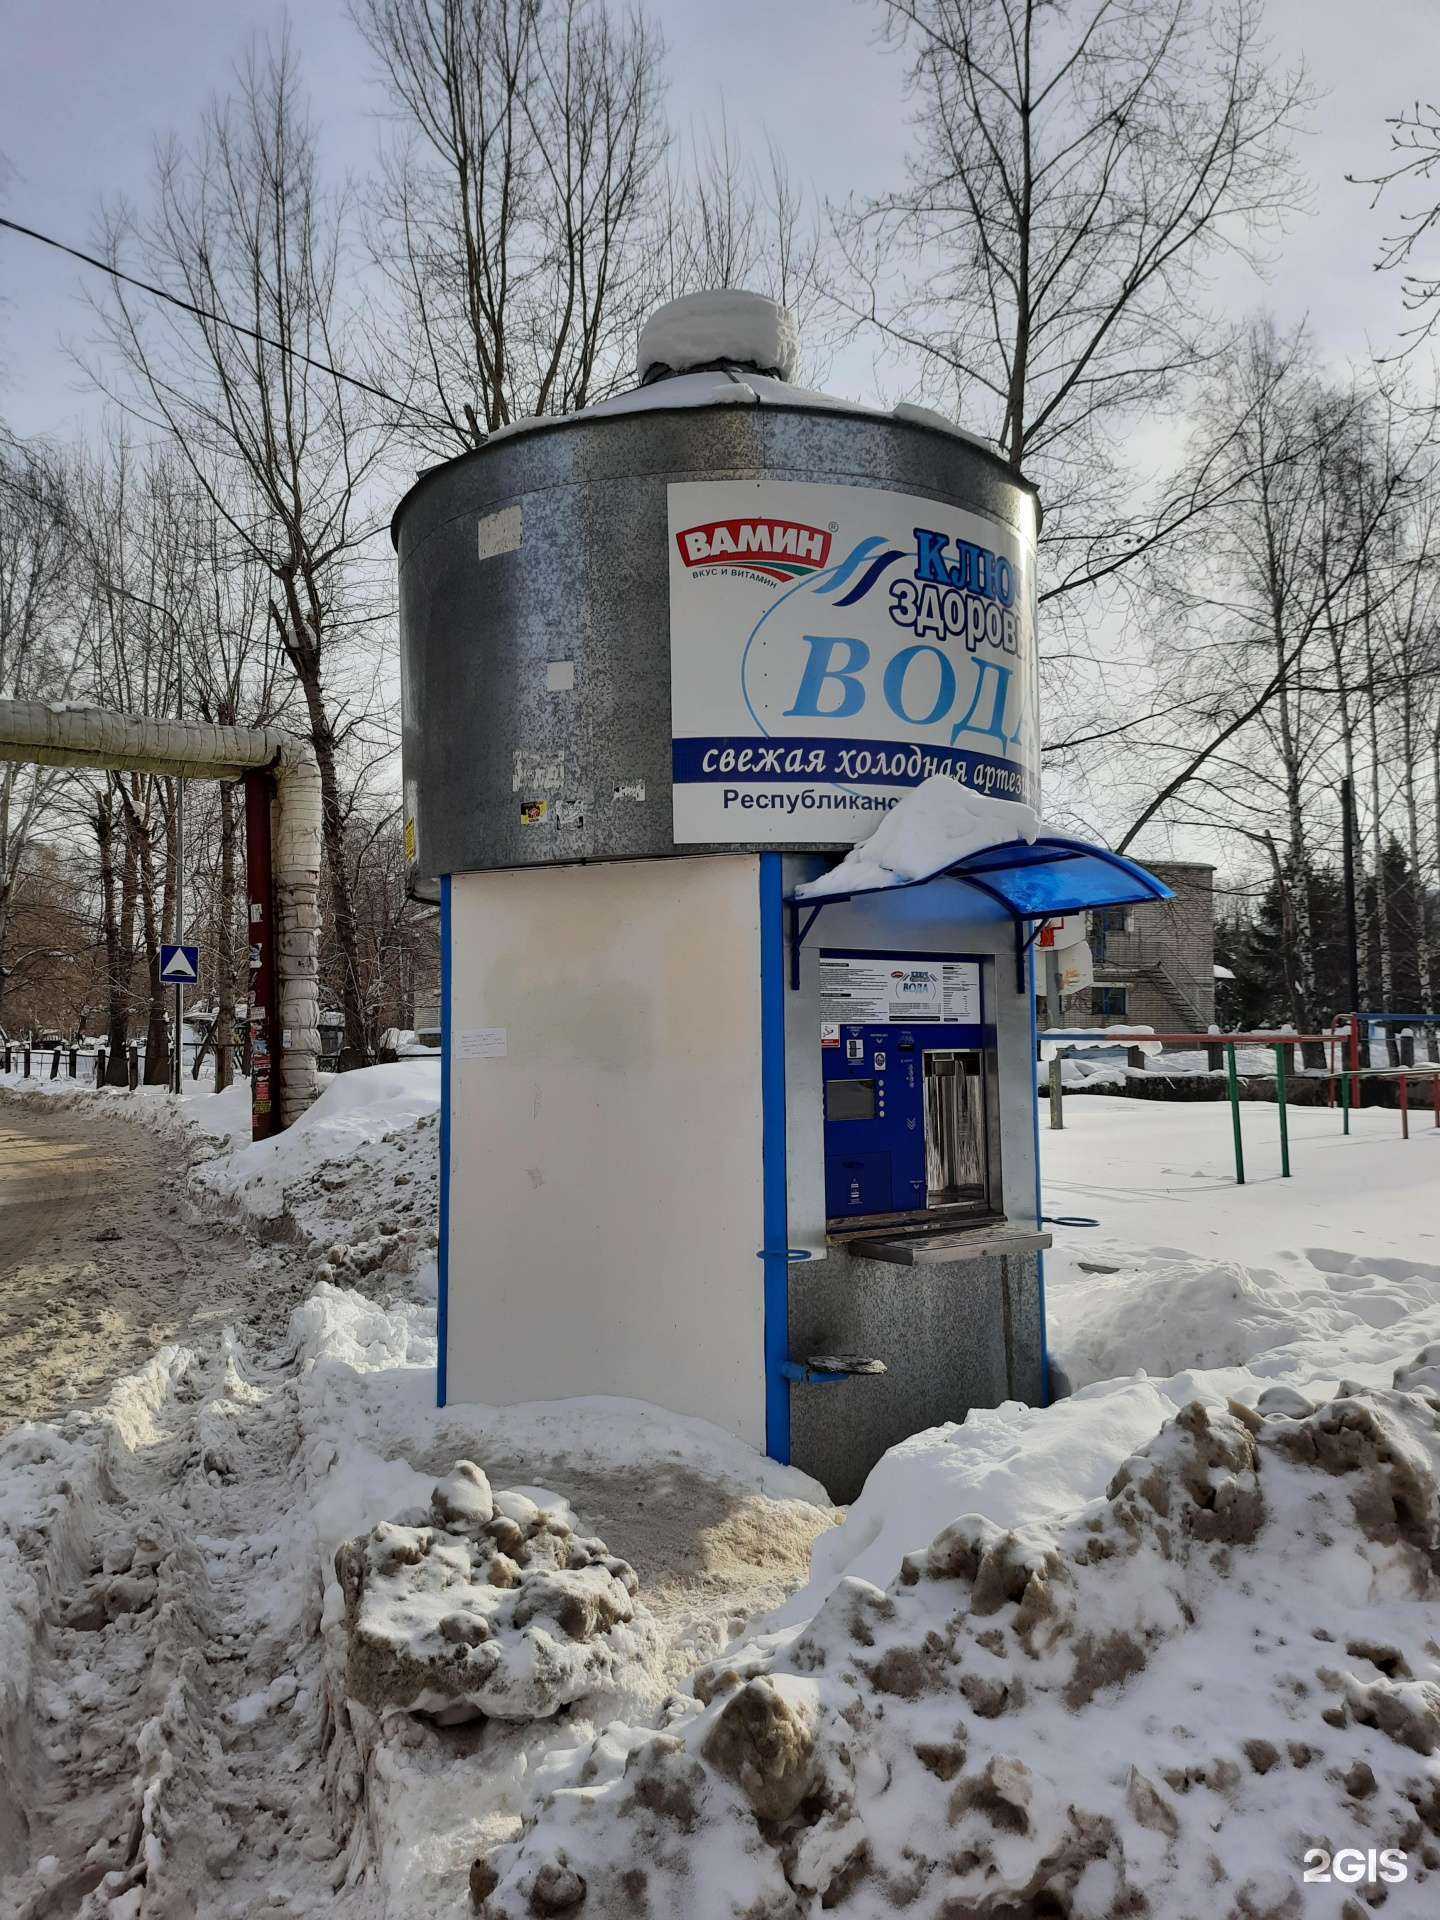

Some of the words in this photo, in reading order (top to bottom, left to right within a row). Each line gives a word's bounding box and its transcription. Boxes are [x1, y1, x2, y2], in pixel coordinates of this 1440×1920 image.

[683, 524, 824, 561] ВАМИН
[692, 568, 718, 579] ВКУС
[721, 568, 729, 576] И
[731, 569, 778, 589] ВИТАМИН
[913, 527, 1019, 609] КЛЮ
[702, 748, 826, 774] свежая
[834, 744, 967, 783] холодная
